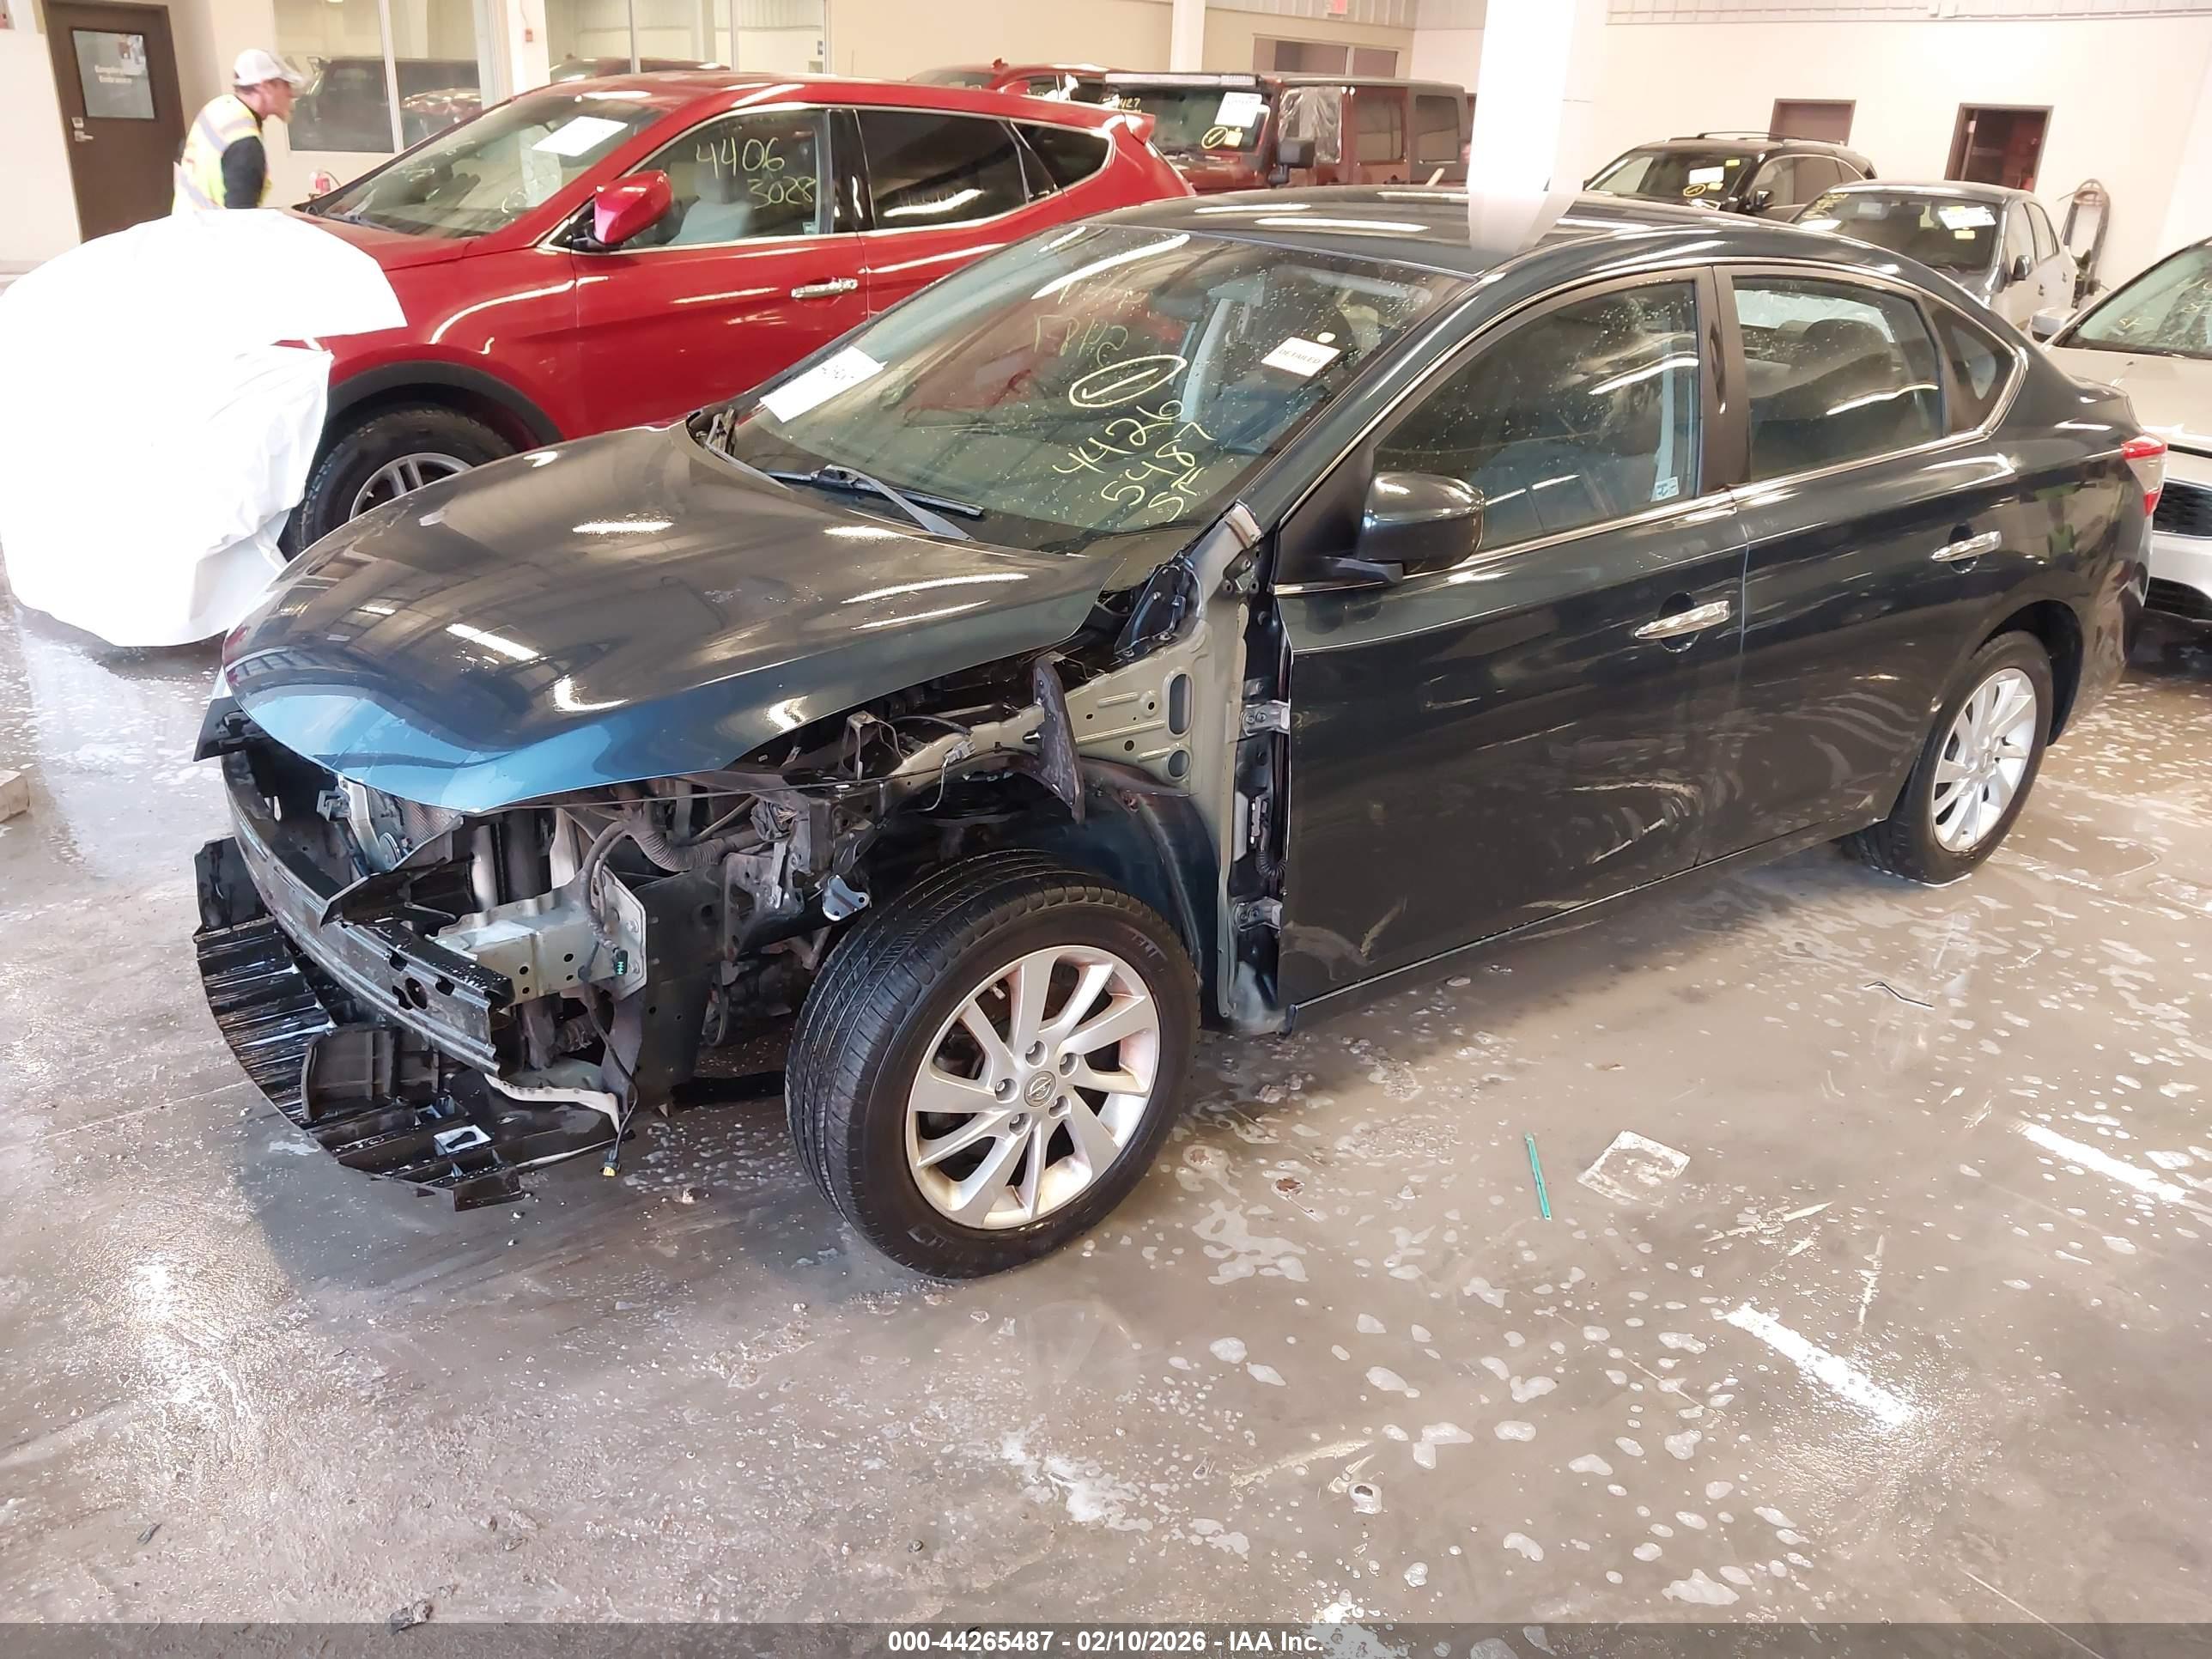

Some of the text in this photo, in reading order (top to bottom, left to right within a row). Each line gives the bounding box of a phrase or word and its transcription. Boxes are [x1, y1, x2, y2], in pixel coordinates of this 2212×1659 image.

[696, 137, 785, 179] 4406
[747, 176, 816, 210] 3028
[1278, 349, 1322, 364] DETAILED
[1052, 399, 1184, 474] 4426
[1101, 422, 1218, 507] 5487
